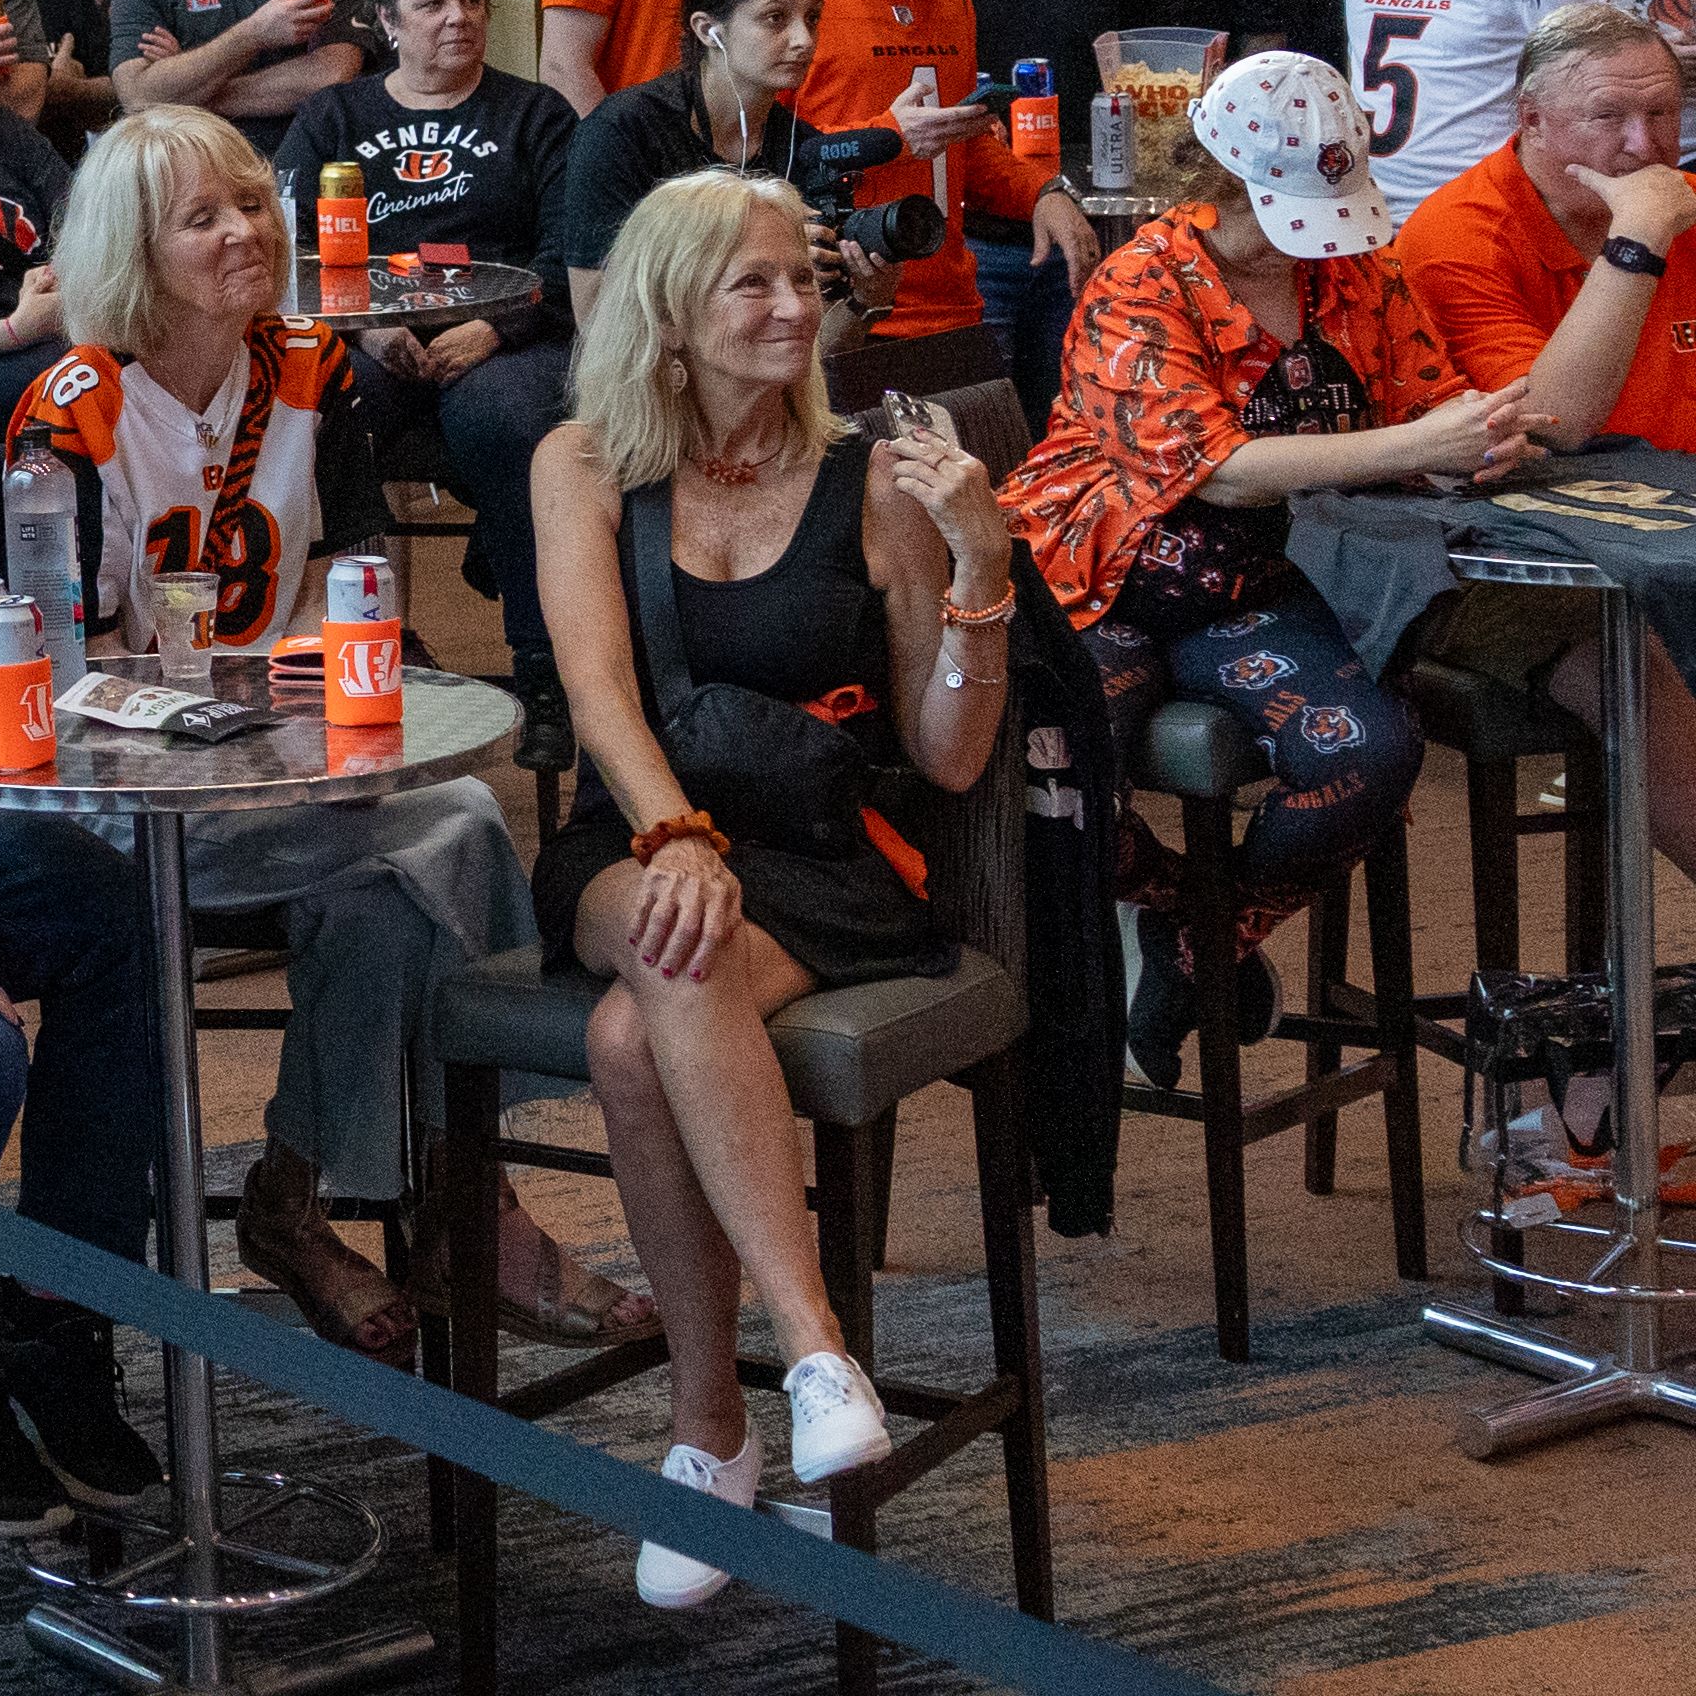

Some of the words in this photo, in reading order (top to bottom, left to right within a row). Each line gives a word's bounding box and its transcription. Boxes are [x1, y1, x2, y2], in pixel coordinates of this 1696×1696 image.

[873, 44, 958, 58] BENGALS
[1362, 12, 1433, 158] 5
[355, 121, 499, 159] BENGALS
[1111, 121, 1125, 175] ULTRA
[366, 171, 473, 223] Cincinnati
[145, 499, 282, 647] 18
